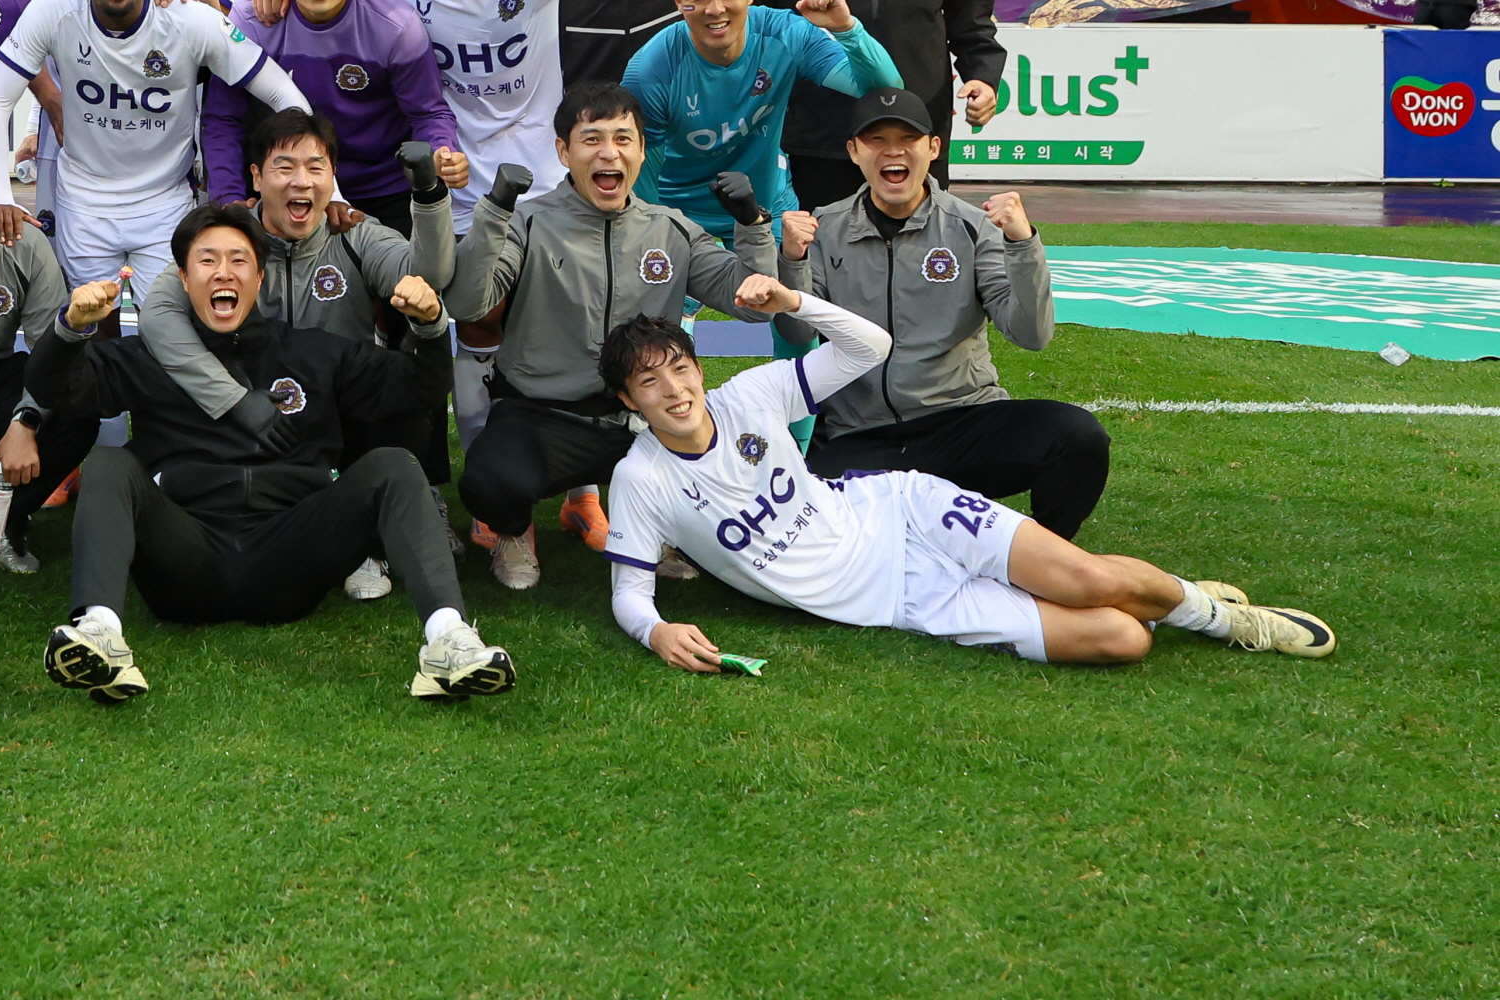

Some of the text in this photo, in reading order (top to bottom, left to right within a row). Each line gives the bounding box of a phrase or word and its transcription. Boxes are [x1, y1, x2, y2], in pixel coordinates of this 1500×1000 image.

[431, 32, 529, 74] OHC
[75, 78, 172, 114] OHC
[1401, 91, 1464, 112] DONG
[82, 112, 167, 131] 오상헬스케어
[1409, 111, 1458, 127] WON
[962, 144, 1115, 161] 휘발유의 시작
[715, 466, 796, 552] OHC
[941, 494, 993, 539] 28
[983, 511, 1002, 530] VEXX
[751, 500, 820, 571] 오상헬스케어
